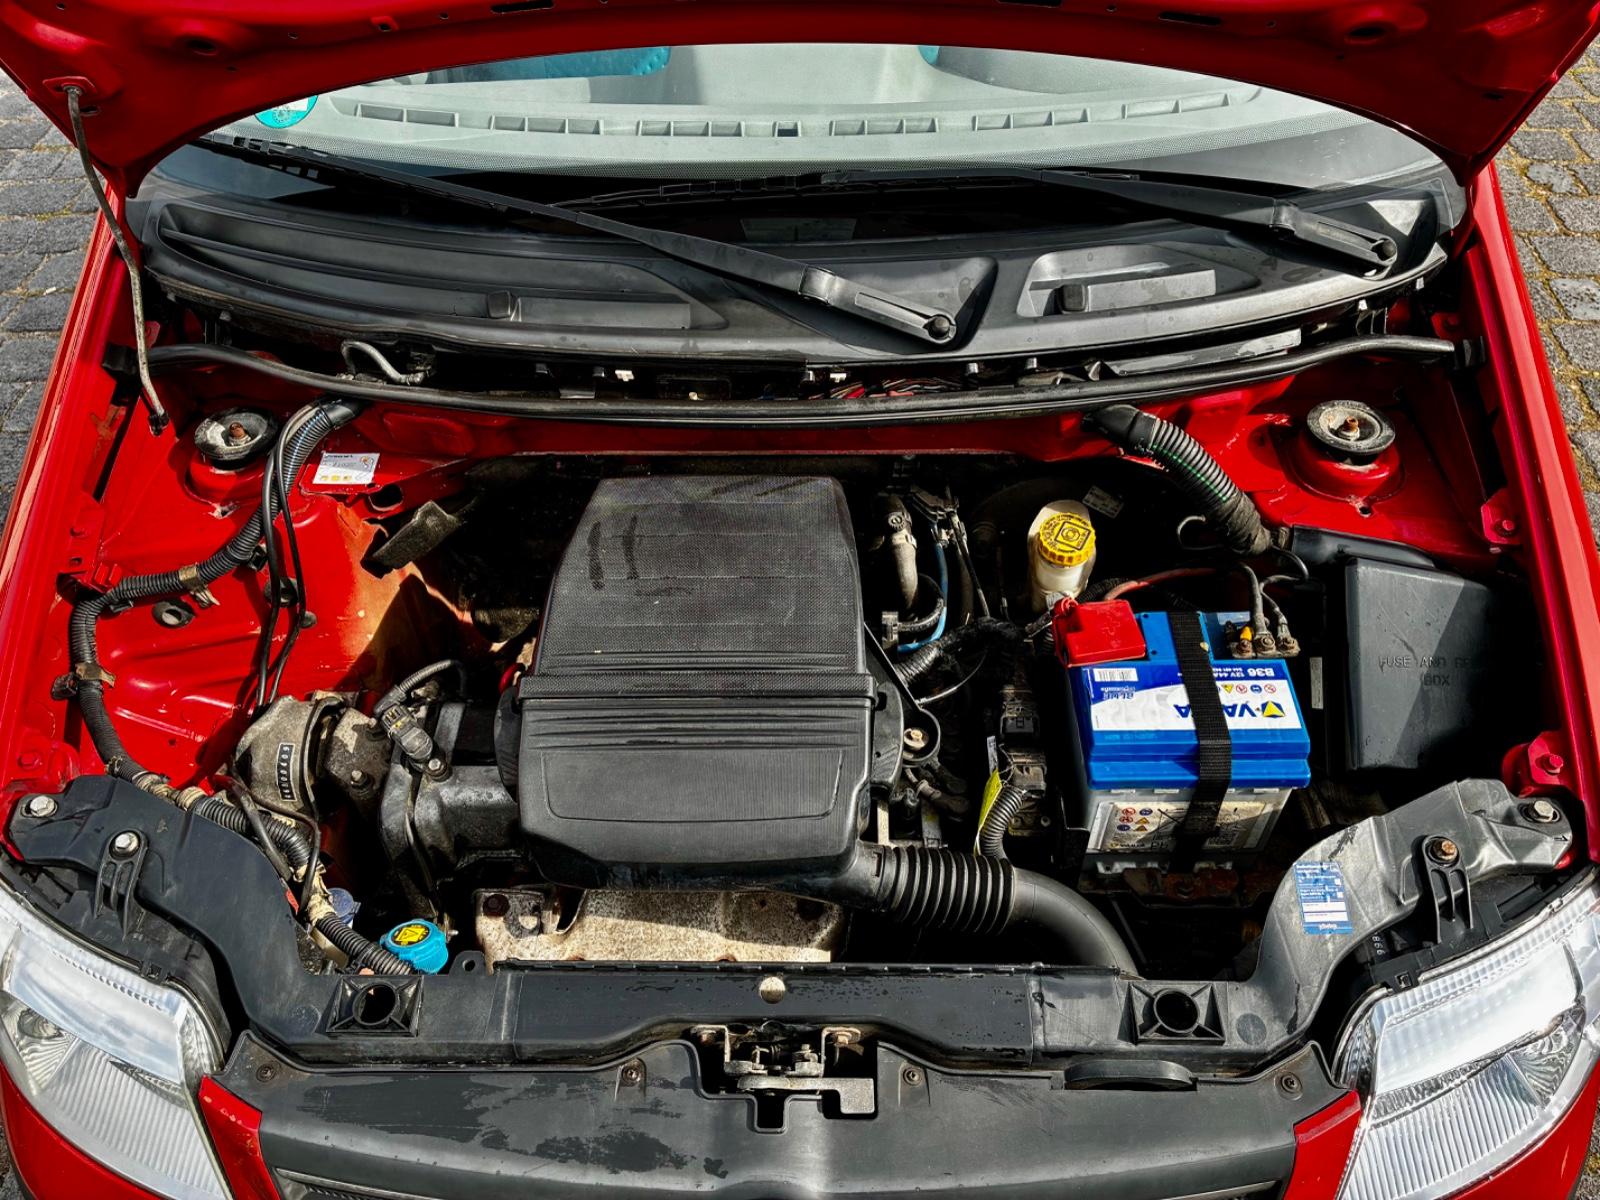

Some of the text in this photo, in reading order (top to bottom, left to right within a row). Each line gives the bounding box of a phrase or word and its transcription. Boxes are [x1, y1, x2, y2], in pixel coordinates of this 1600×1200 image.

[1379, 656, 1410, 669] FUSE
[1247, 667, 1275, 677] B36
[1423, 674, 1450, 686] BOX
